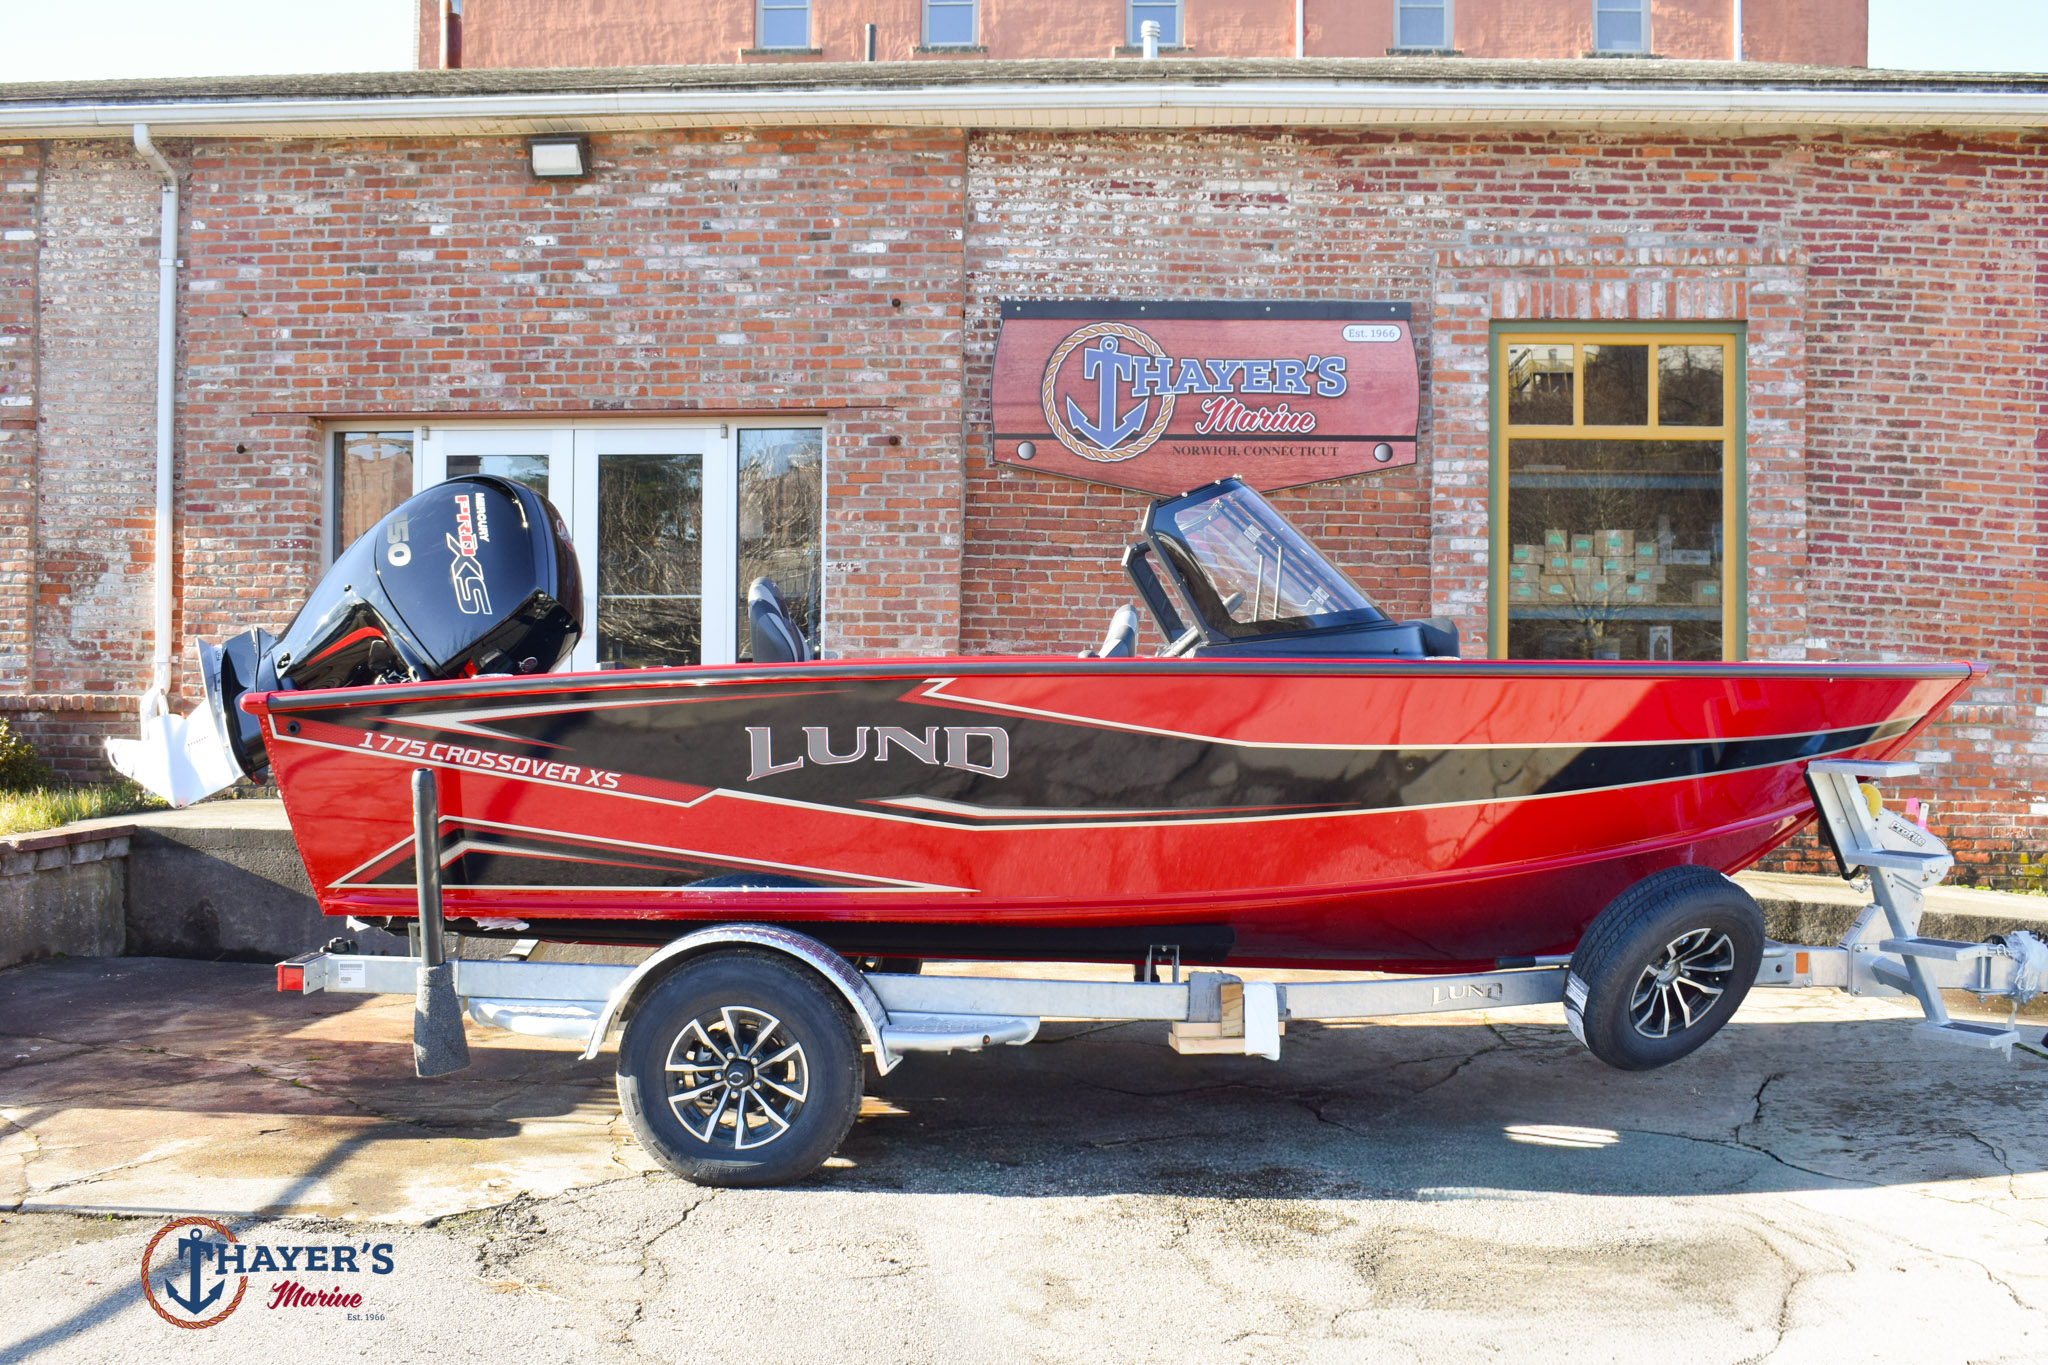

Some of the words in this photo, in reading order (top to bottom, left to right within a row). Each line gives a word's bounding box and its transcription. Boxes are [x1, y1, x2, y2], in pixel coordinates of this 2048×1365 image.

[1348, 328, 1368, 338] Est.
[1371, 328, 1396, 338] 1966
[1083, 346, 1347, 430] THAYER'S
[1195, 396, 1316, 434] Marine
[1172, 445, 1240, 457] NORWICH,
[1243, 446, 1340, 458] CONNECTICUT
[386, 511, 412, 567] 150
[454, 494, 478, 557] PRO
[474, 492, 490, 543] MERCURY
[446, 532, 493, 615] XS
[358, 732, 428, 757] 1775
[429, 743, 581, 782] CROSSOVER
[585, 769, 622, 789] XS
[744, 726, 1009, 782] LUND
[1431, 982, 1503, 1007] LUND
